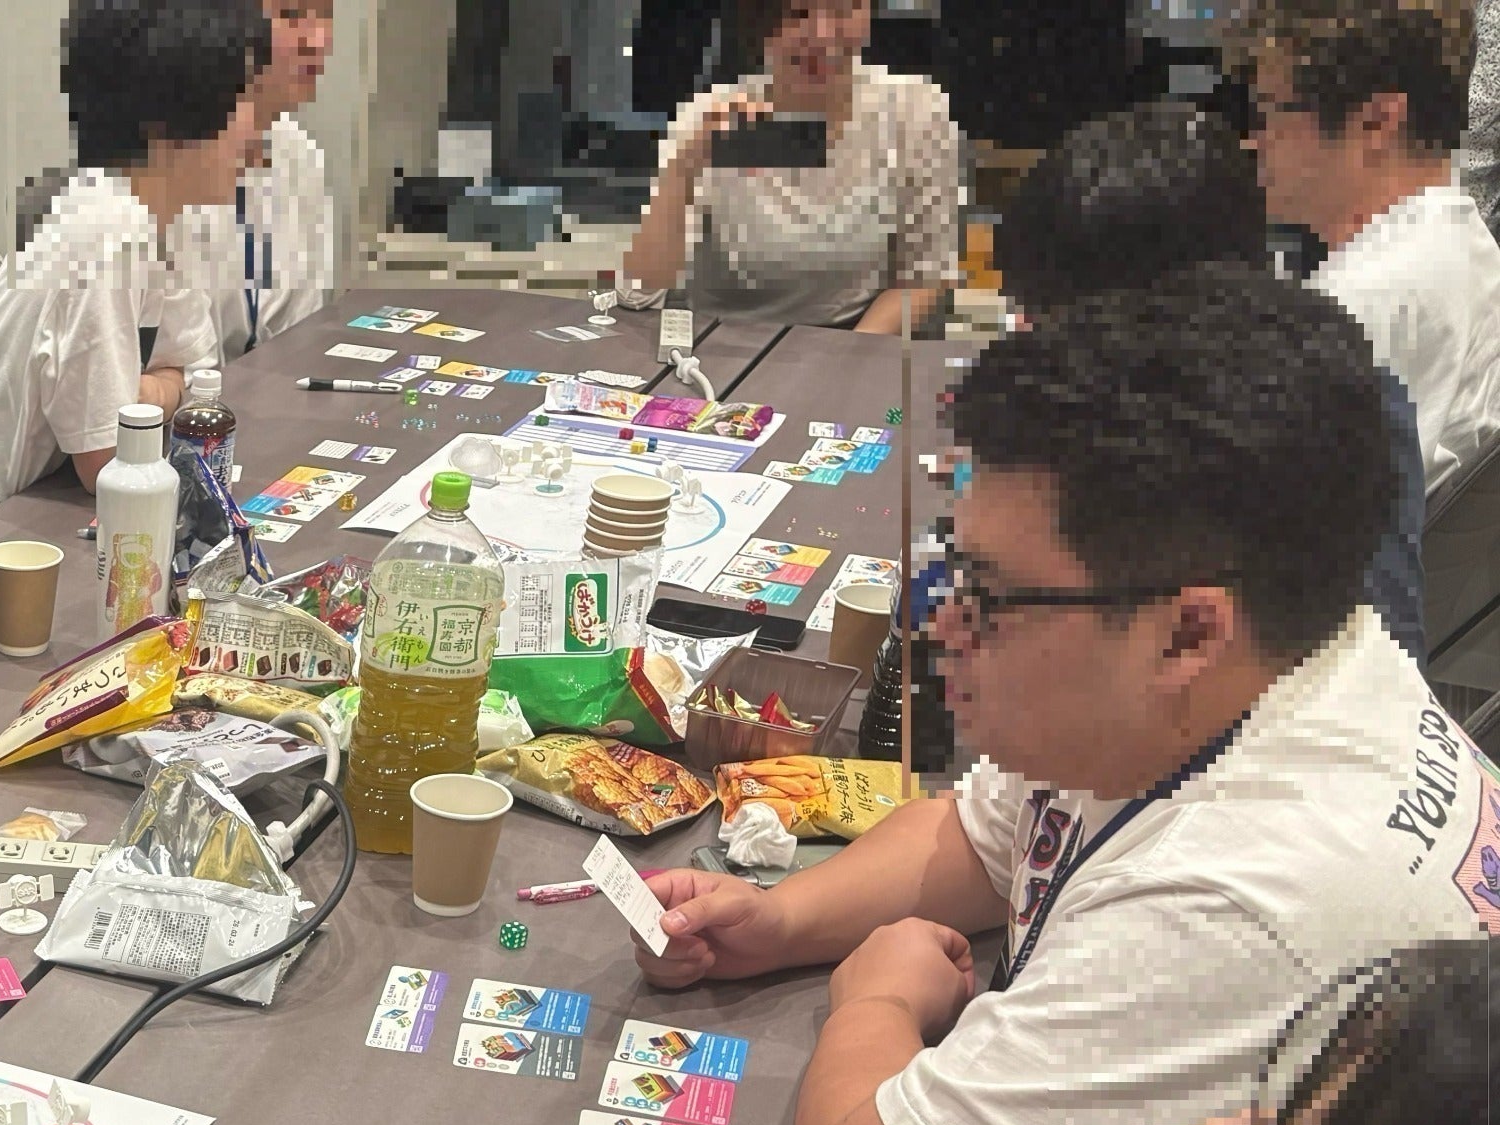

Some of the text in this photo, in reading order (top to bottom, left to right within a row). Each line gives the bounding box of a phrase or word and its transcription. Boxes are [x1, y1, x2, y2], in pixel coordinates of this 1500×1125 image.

[389, 600, 420, 671] 伊右衛門
[414, 613, 429, 664] いえもん
[453, 618, 476, 654] 京都
[576, 581, 598, 646] ばかうけ
